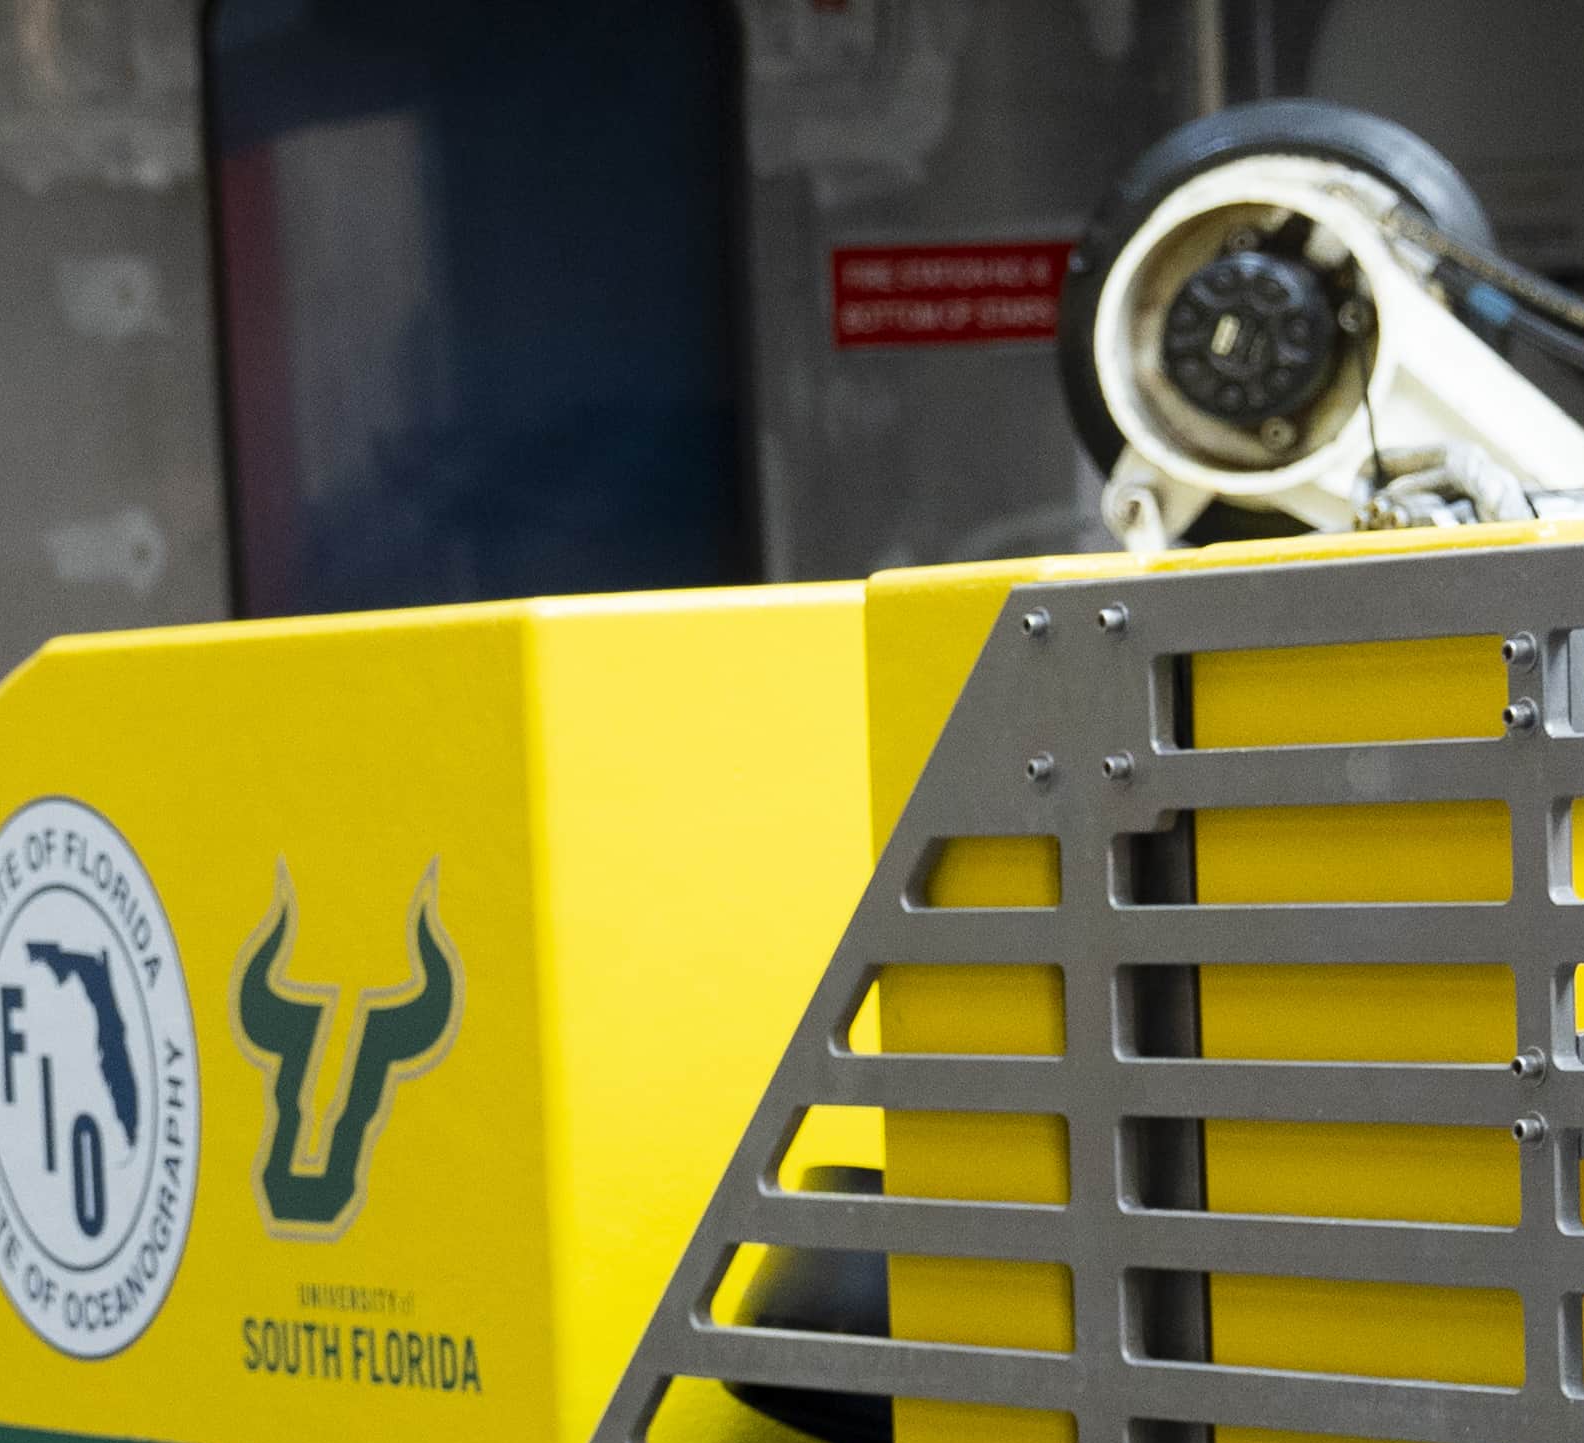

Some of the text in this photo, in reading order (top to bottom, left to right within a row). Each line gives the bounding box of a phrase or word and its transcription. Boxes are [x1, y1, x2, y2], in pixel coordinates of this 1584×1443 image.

[24, 828, 56, 872] OF
[64, 830, 162, 989] FLORIDA
[23, 1262, 58, 1312] OF
[63, 1037, 186, 1332] OCEANOGRAPHY
[242, 1316, 483, 1394] SOUTH FLORIDA
